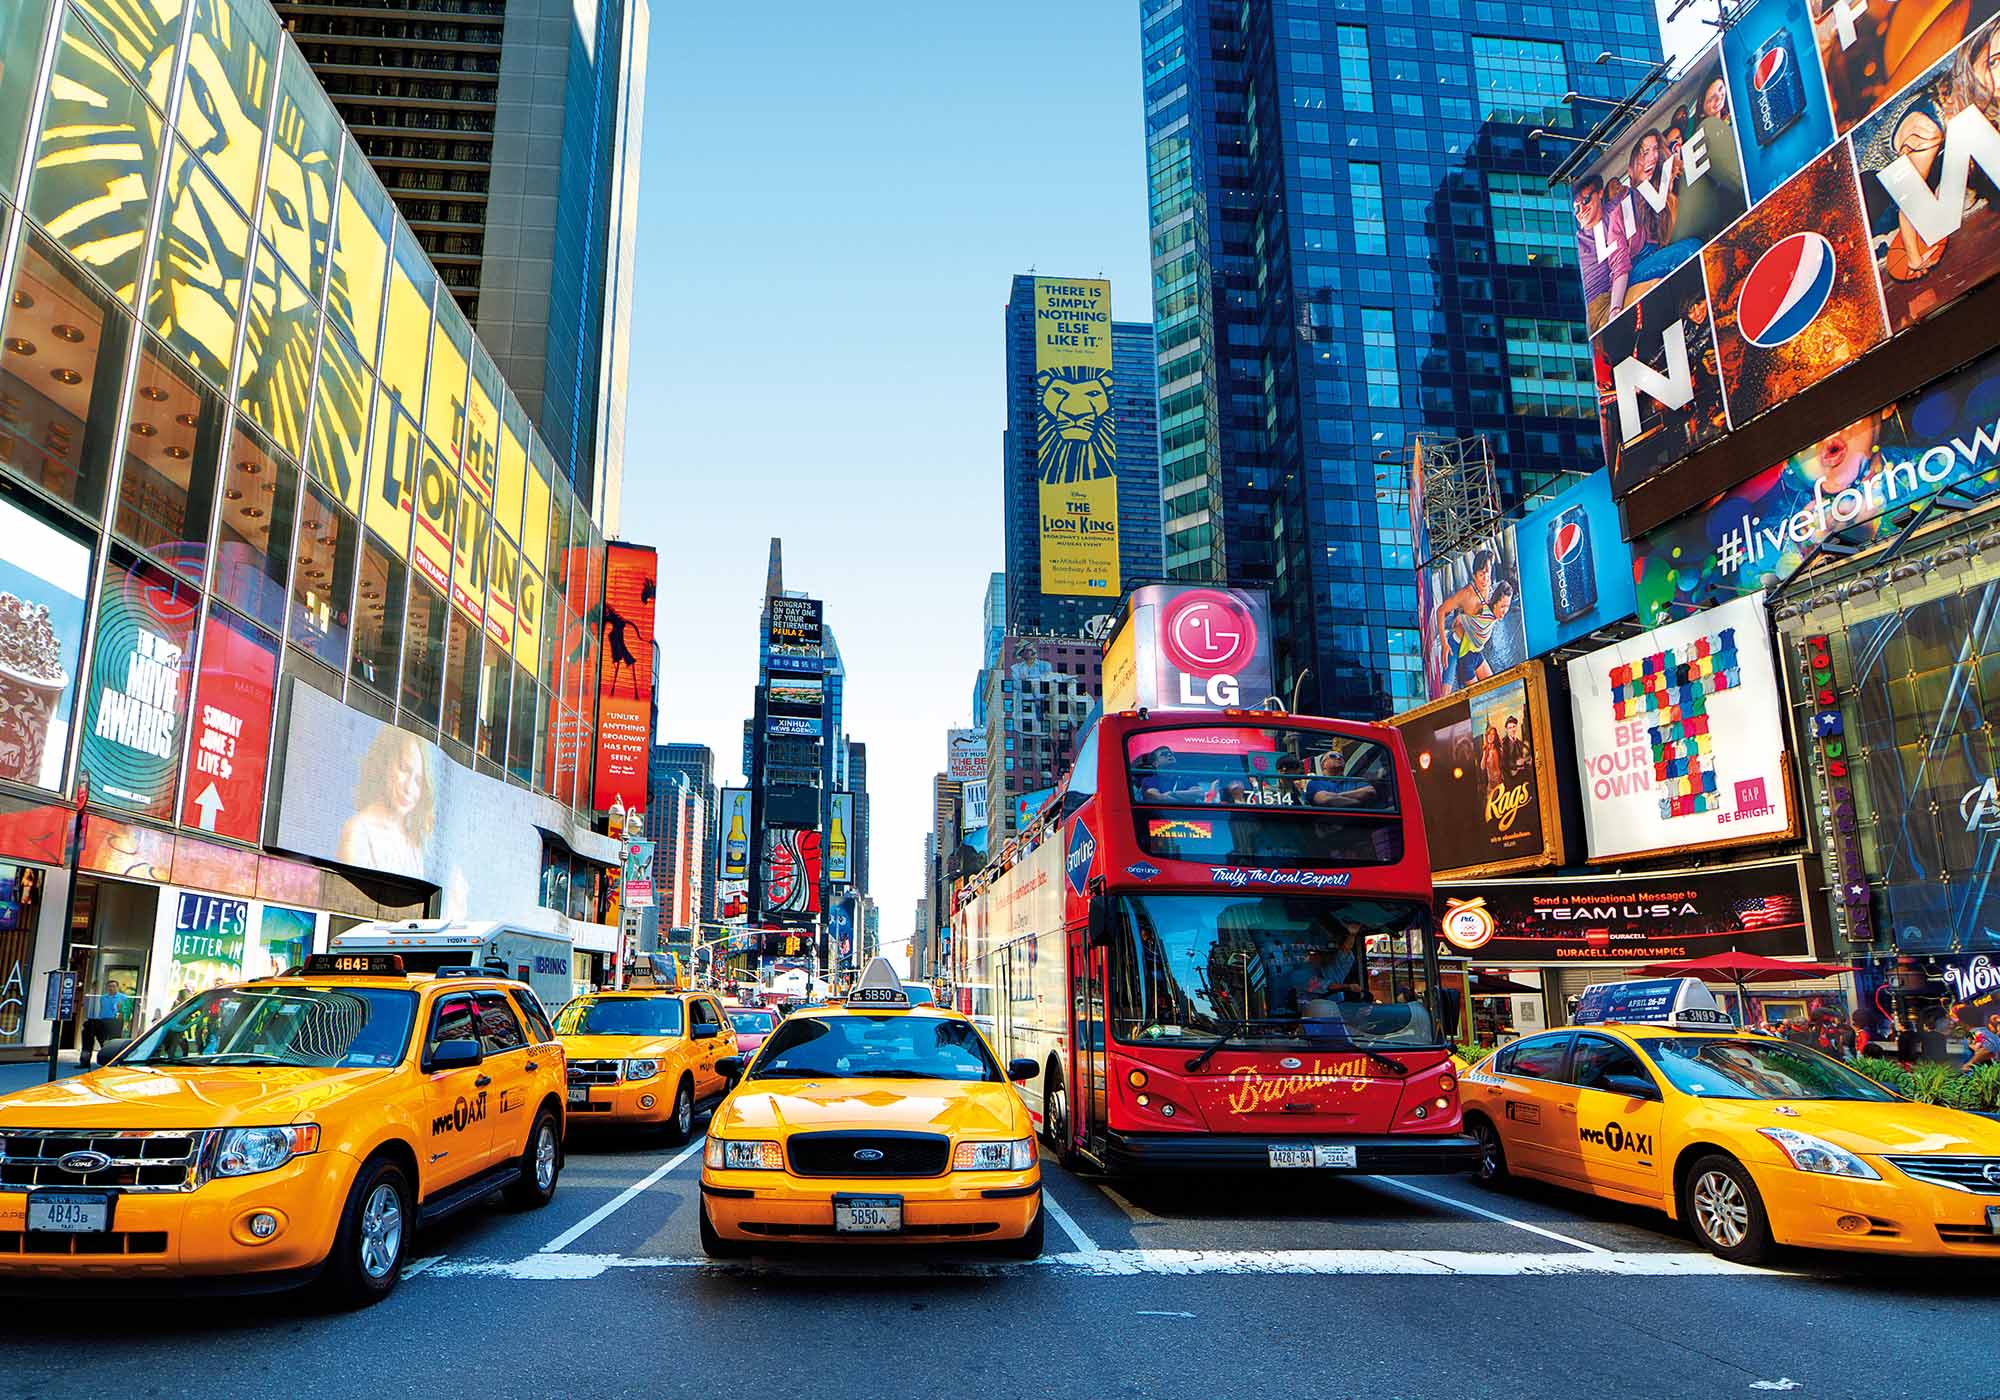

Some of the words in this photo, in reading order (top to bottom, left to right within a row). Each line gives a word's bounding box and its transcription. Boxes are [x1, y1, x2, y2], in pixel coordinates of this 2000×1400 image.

[1757, 92, 1775, 131] pepsi
[1593, 128, 1711, 263] LIVE
[1089, 288, 1101, 297] IS
[1048, 298, 1096, 309] SIMPLY
[1038, 309, 1107, 322] NOTHING
[1057, 323, 1088, 334] ELSE
[1047, 335, 1078, 346] LIKE
[451, 393, 494, 488] THE
[382, 384, 469, 553] LION
[470, 490, 535, 625] KING
[1066, 503, 1090, 512] THE
[1043, 514, 1076, 532] LION
[1080, 516, 1115, 534] KING
[1554, 568, 1570, 609] pepsi
[773, 600, 812, 610] CONGRATS
[801, 609, 817, 617] ONE
[773, 621, 819, 631] RETIREMENT
[784, 615, 804, 623] YOUR
[772, 628, 797, 636] PAULA
[1179, 672, 1240, 707] LG
[95, 687, 176, 759] AWARDS
[202, 704, 243, 738] SUNDAY
[602, 722, 646, 732] ANYTHING
[778, 719, 811, 728] XINHUA
[200, 728, 227, 753] JUNE
[602, 732, 646, 742] BROADWAY
[1184, 734, 1240, 744] www.LG.com
[1615, 720, 1645, 748] BE
[603, 743, 621, 751] HAS
[622, 744, 643, 752] EVER
[197, 750, 219, 776] LIVE
[1584, 746, 1649, 778] YOUR
[1593, 769, 1650, 801] OWN
[1243, 790, 1294, 805] 71514
[1741, 786, 1760, 803] GAP
[1484, 781, 1530, 832] Rags
[1717, 813, 1732, 824] BE
[1734, 804, 1776, 822] BRIGHT
[767, 843, 793, 904] Coke
[1210, 867, 1247, 887] Truly,
[1248, 869, 1268, 881] The
[1268, 869, 1301, 884] Local
[1300, 871, 1350, 887] Expert!
[1533, 896, 1560, 905] Send
[1562, 897, 1569, 905] a
[1571, 893, 1636, 904] Motivational
[1638, 892, 1685, 904] Message
[1687, 891, 1697, 899] to
[177, 895, 247, 935] LIFE'S
[1534, 906, 1617, 921] TEAM
[174, 934, 223, 957] BETTER
[228, 940, 243, 960] IN
[1557, 947, 1686, 958] DURACELL.COM/OLYMPICS
[865, 990, 891, 1000] 5B50
[1628, 999, 1647, 1008] APRIL
[1689, 1009, 1716, 1022] 3N99
[1229, 1056, 1374, 1114] Broadway
[432, 1113, 453, 1136] NYC
[454, 1091, 487, 1132] TAXI
[1579, 1127, 1604, 1145] NYC
[1604, 1121, 1653, 1156] TAXI
